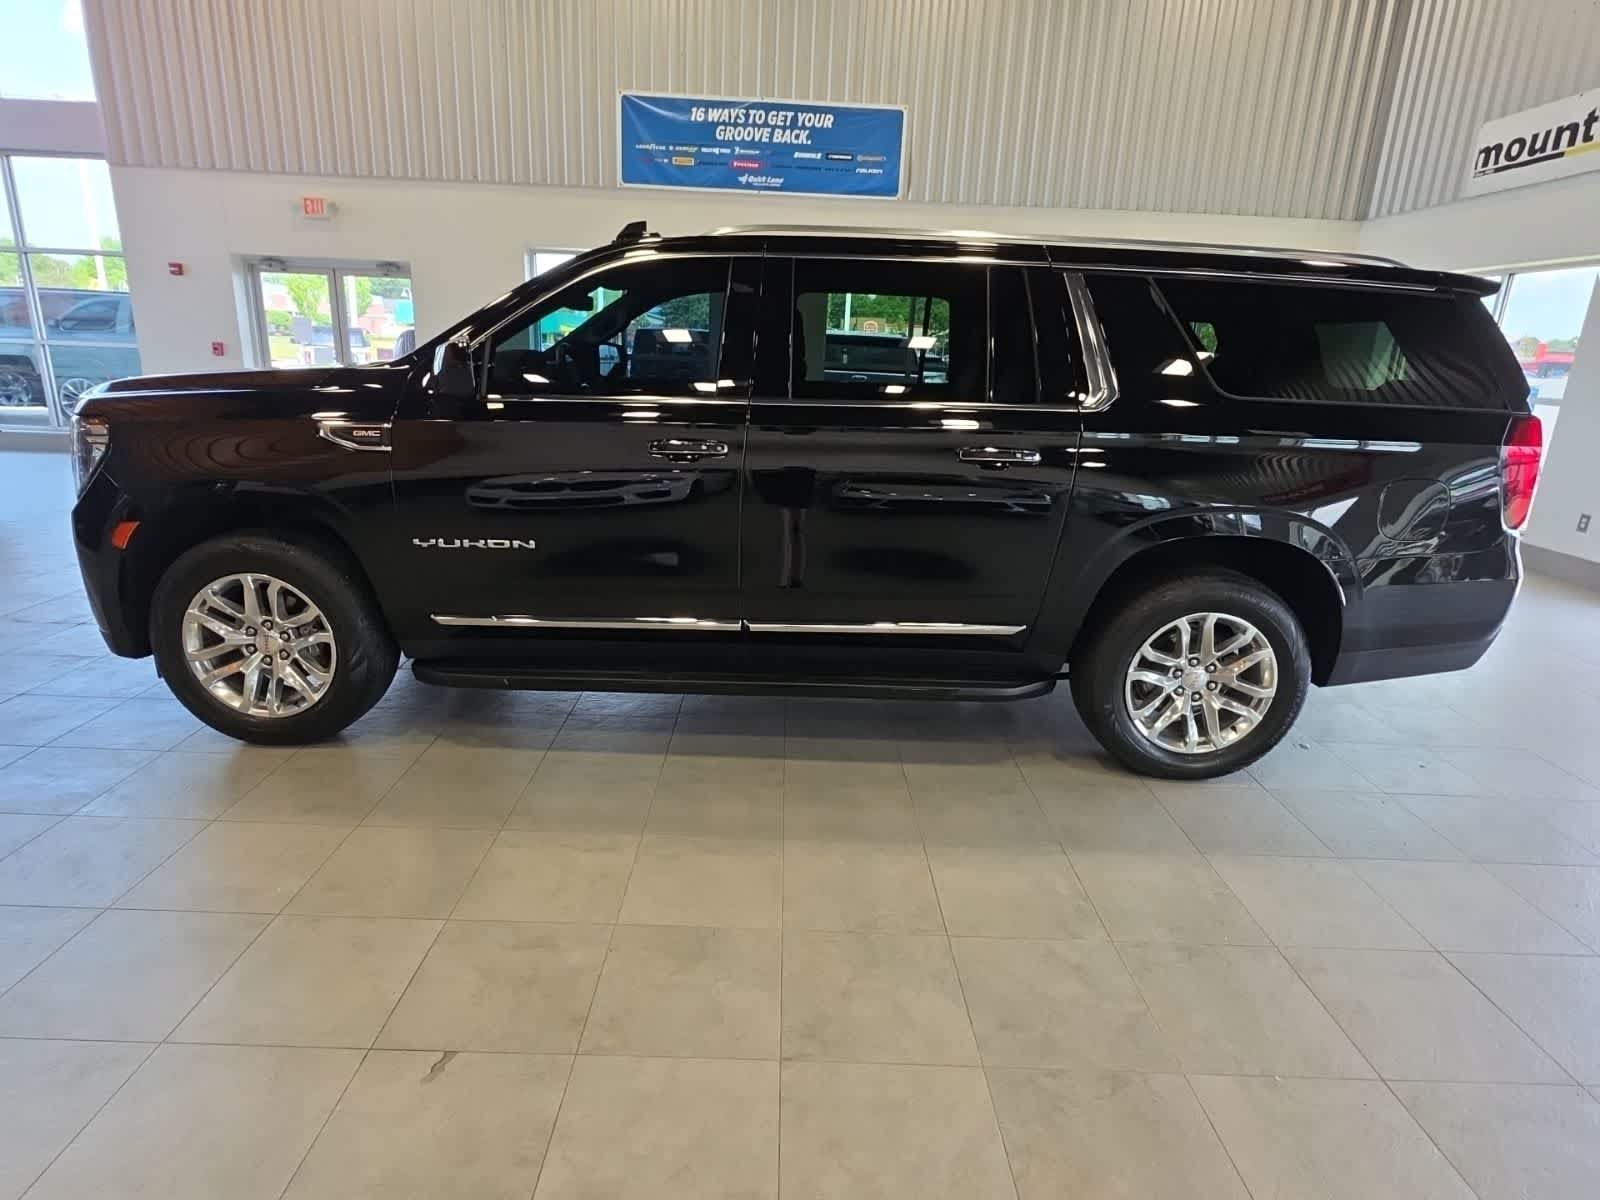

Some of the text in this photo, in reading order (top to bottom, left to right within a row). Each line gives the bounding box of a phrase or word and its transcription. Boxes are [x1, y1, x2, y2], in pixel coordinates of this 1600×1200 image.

[690, 107, 834, 128] 16 WAYS TO GET YOUR
[715, 125, 812, 145] GROOVE BACK.
[304, 198, 325, 214] EXIT
[412, 538, 537, 550] YUKON
